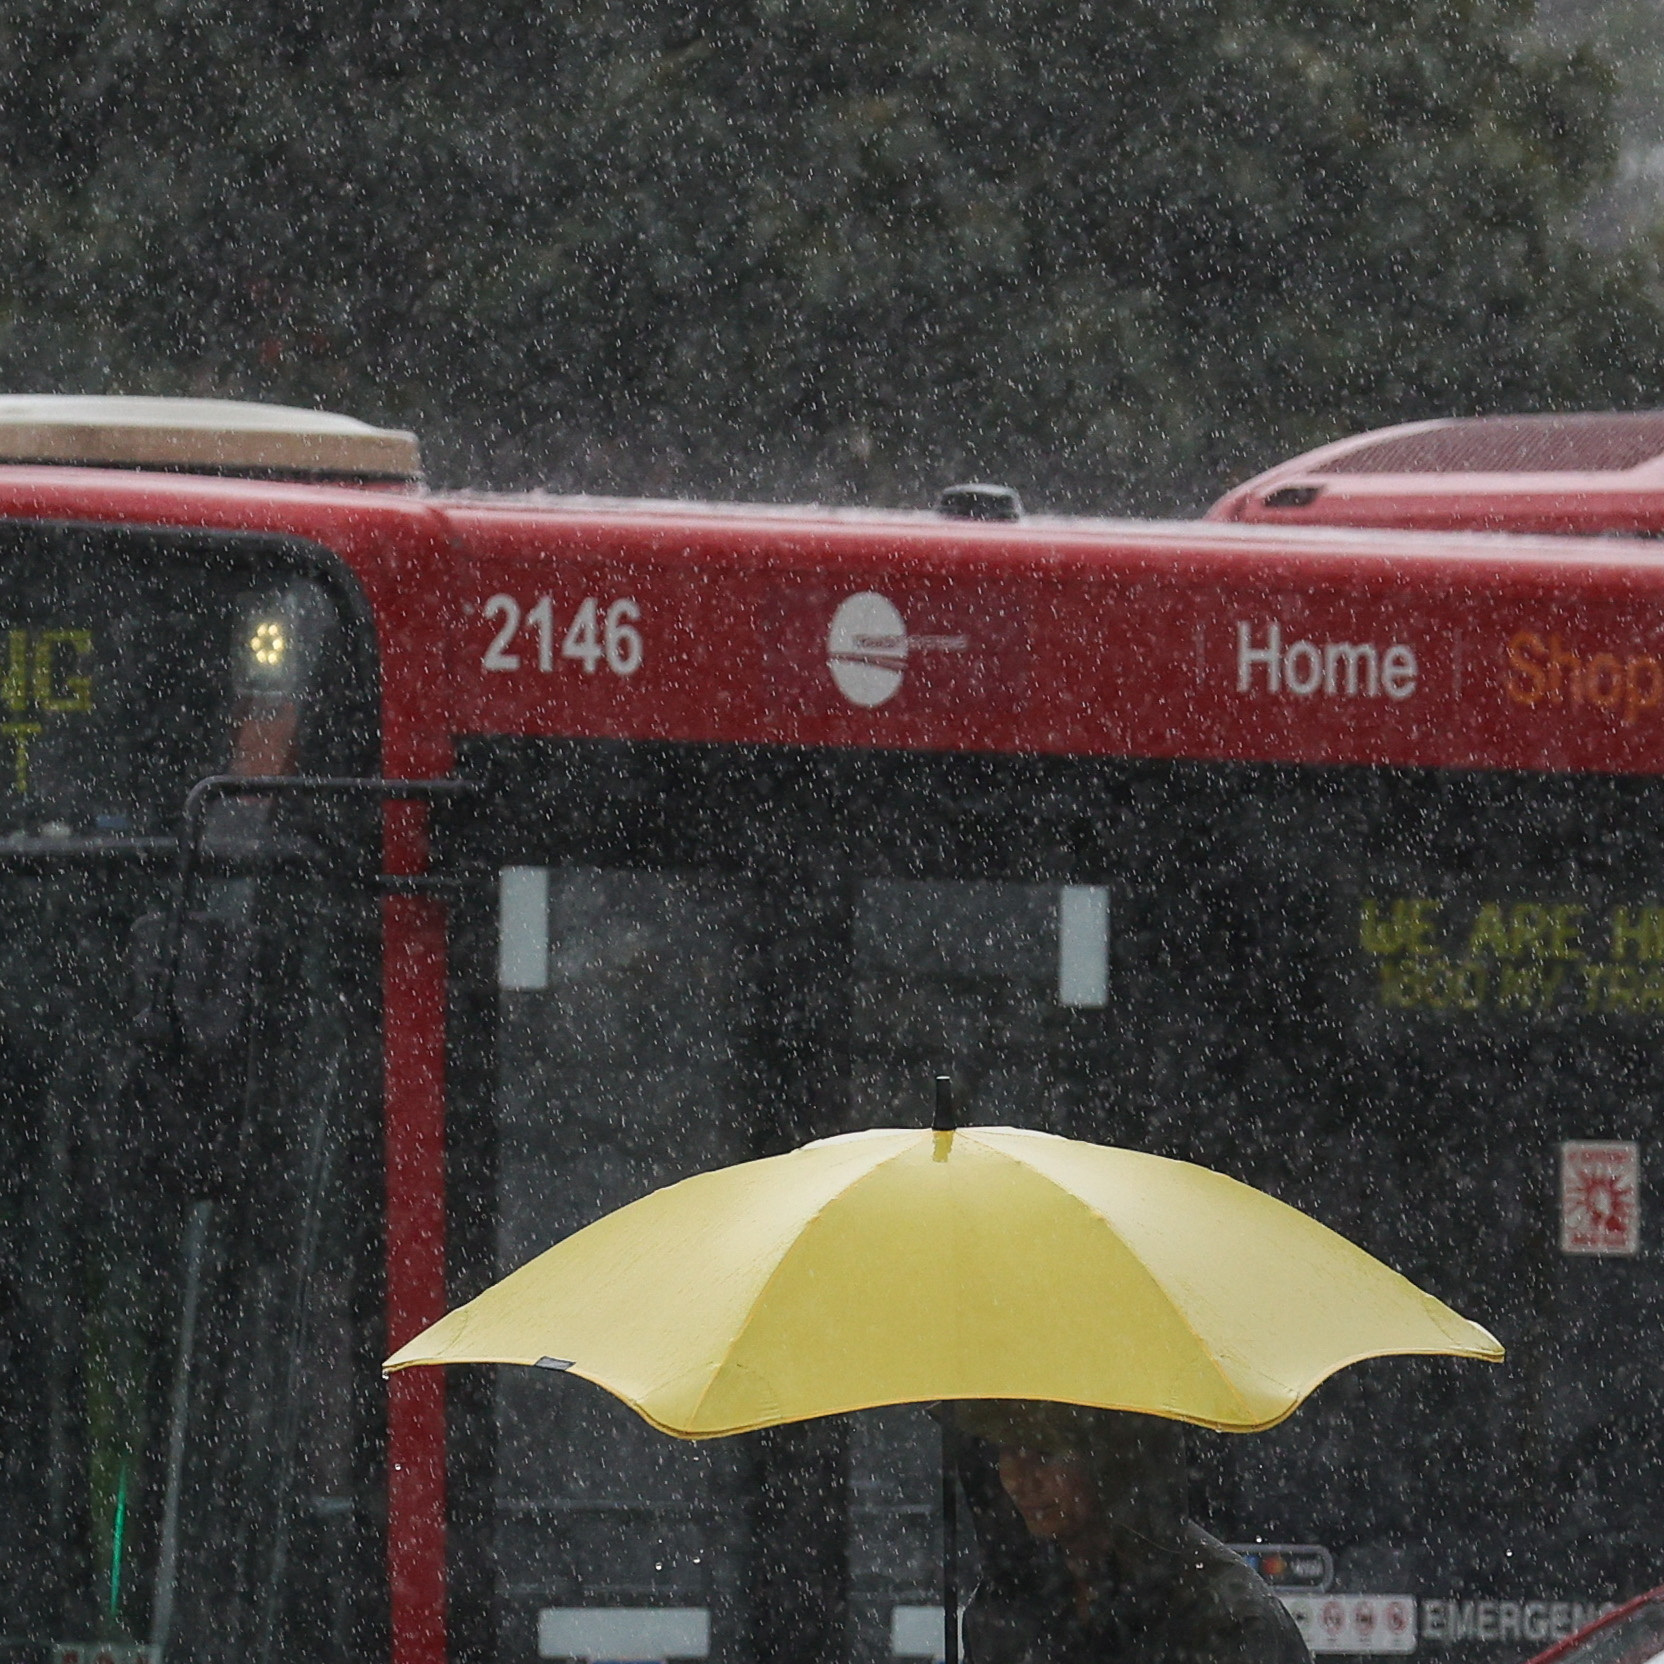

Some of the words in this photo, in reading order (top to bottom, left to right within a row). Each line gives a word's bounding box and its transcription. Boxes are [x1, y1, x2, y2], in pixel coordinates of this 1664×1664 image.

[483, 593, 644, 675] 2146
[1237, 621, 1419, 699] Home
[1359, 899, 1437, 954] WE
[1470, 902, 1587, 961] ARE
